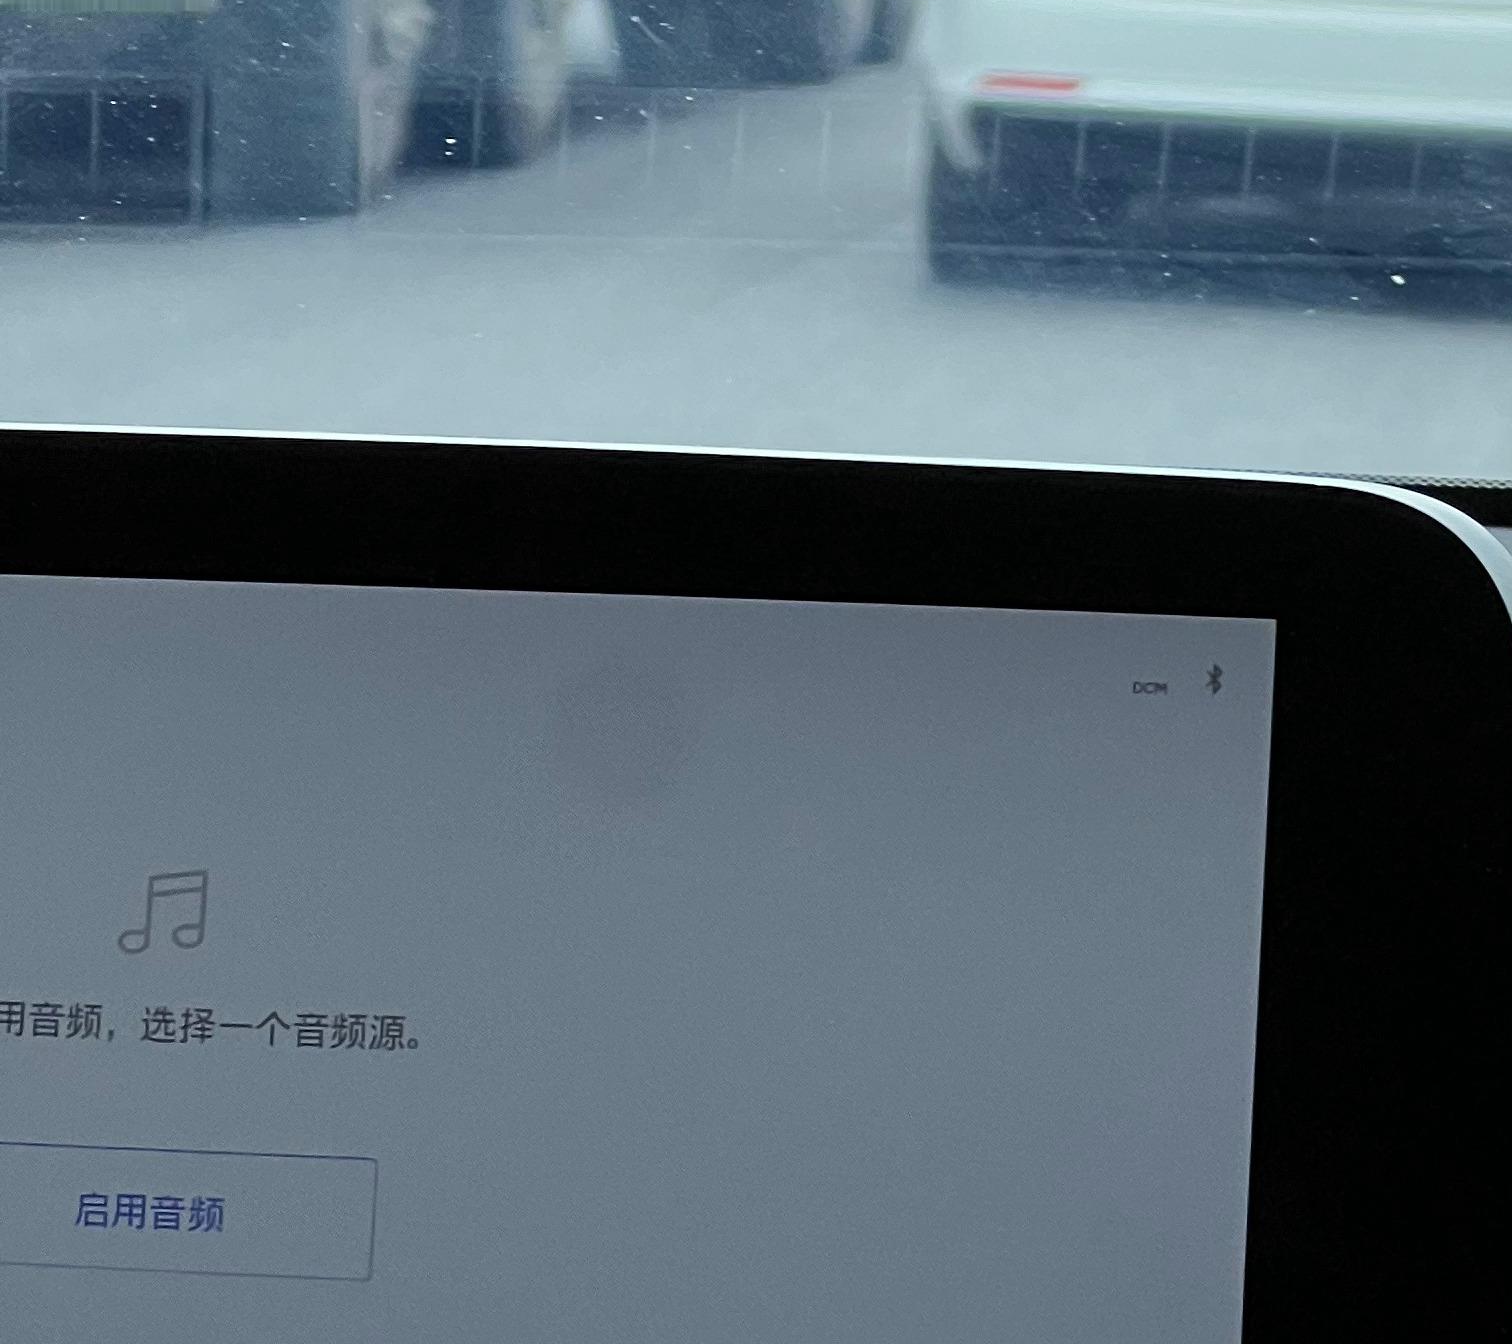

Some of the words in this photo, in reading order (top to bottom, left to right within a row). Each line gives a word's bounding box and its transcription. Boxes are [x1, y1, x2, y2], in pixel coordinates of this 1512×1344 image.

[1132, 680, 1169, 696] DCM
[75, 1191, 226, 1233] 启用音频
